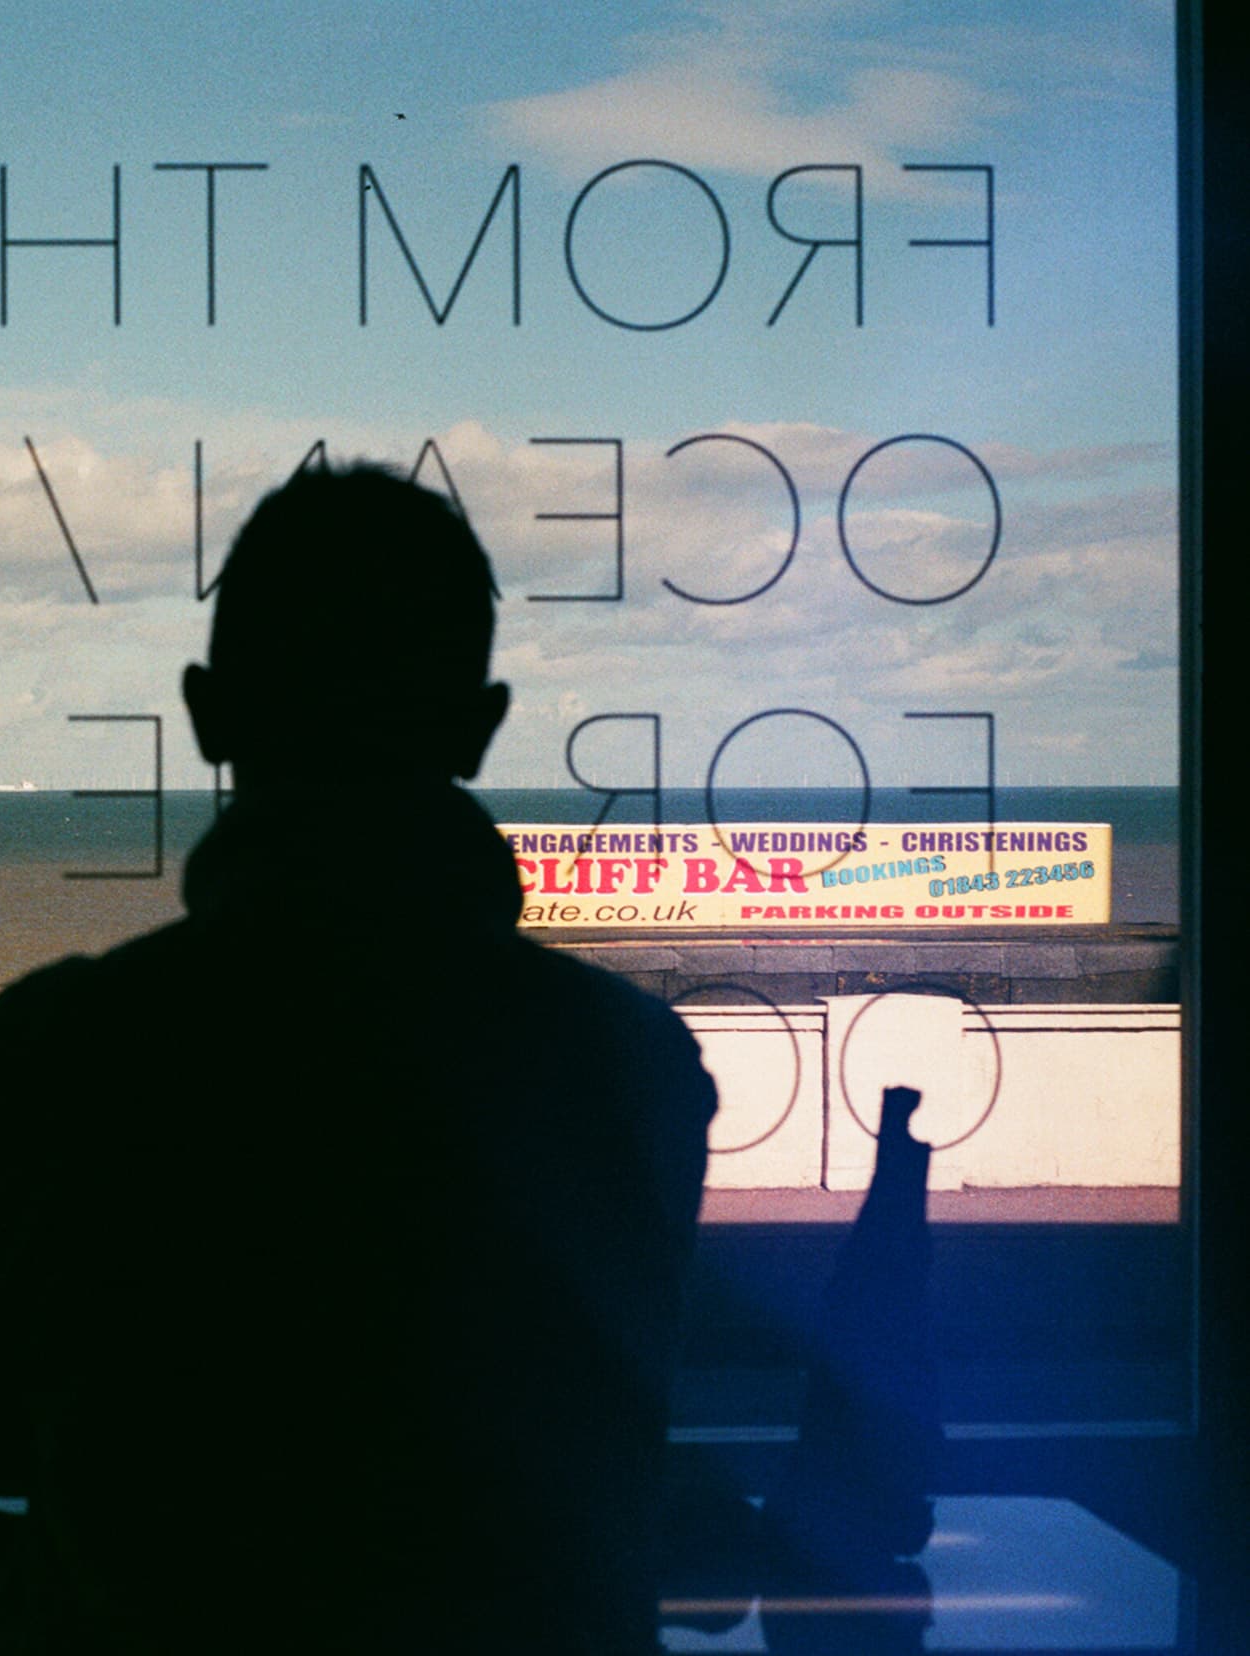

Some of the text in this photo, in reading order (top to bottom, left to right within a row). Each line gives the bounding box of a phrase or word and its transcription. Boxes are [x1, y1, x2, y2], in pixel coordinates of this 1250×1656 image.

[511, 832, 699, 854] ENGAGEMENTS
[730, 831, 868, 853] WEDDINGS
[901, 831, 1089, 852] CHRISTENINGS
[516, 856, 810, 895] CLIFF BAR
[821, 855, 947, 888] BOOKINGS
[929, 860, 1095, 898] 01843 223456
[523, 901, 698, 922] ate.co.uk
[740, 904, 1075, 919] PARKING OUTSIDE
